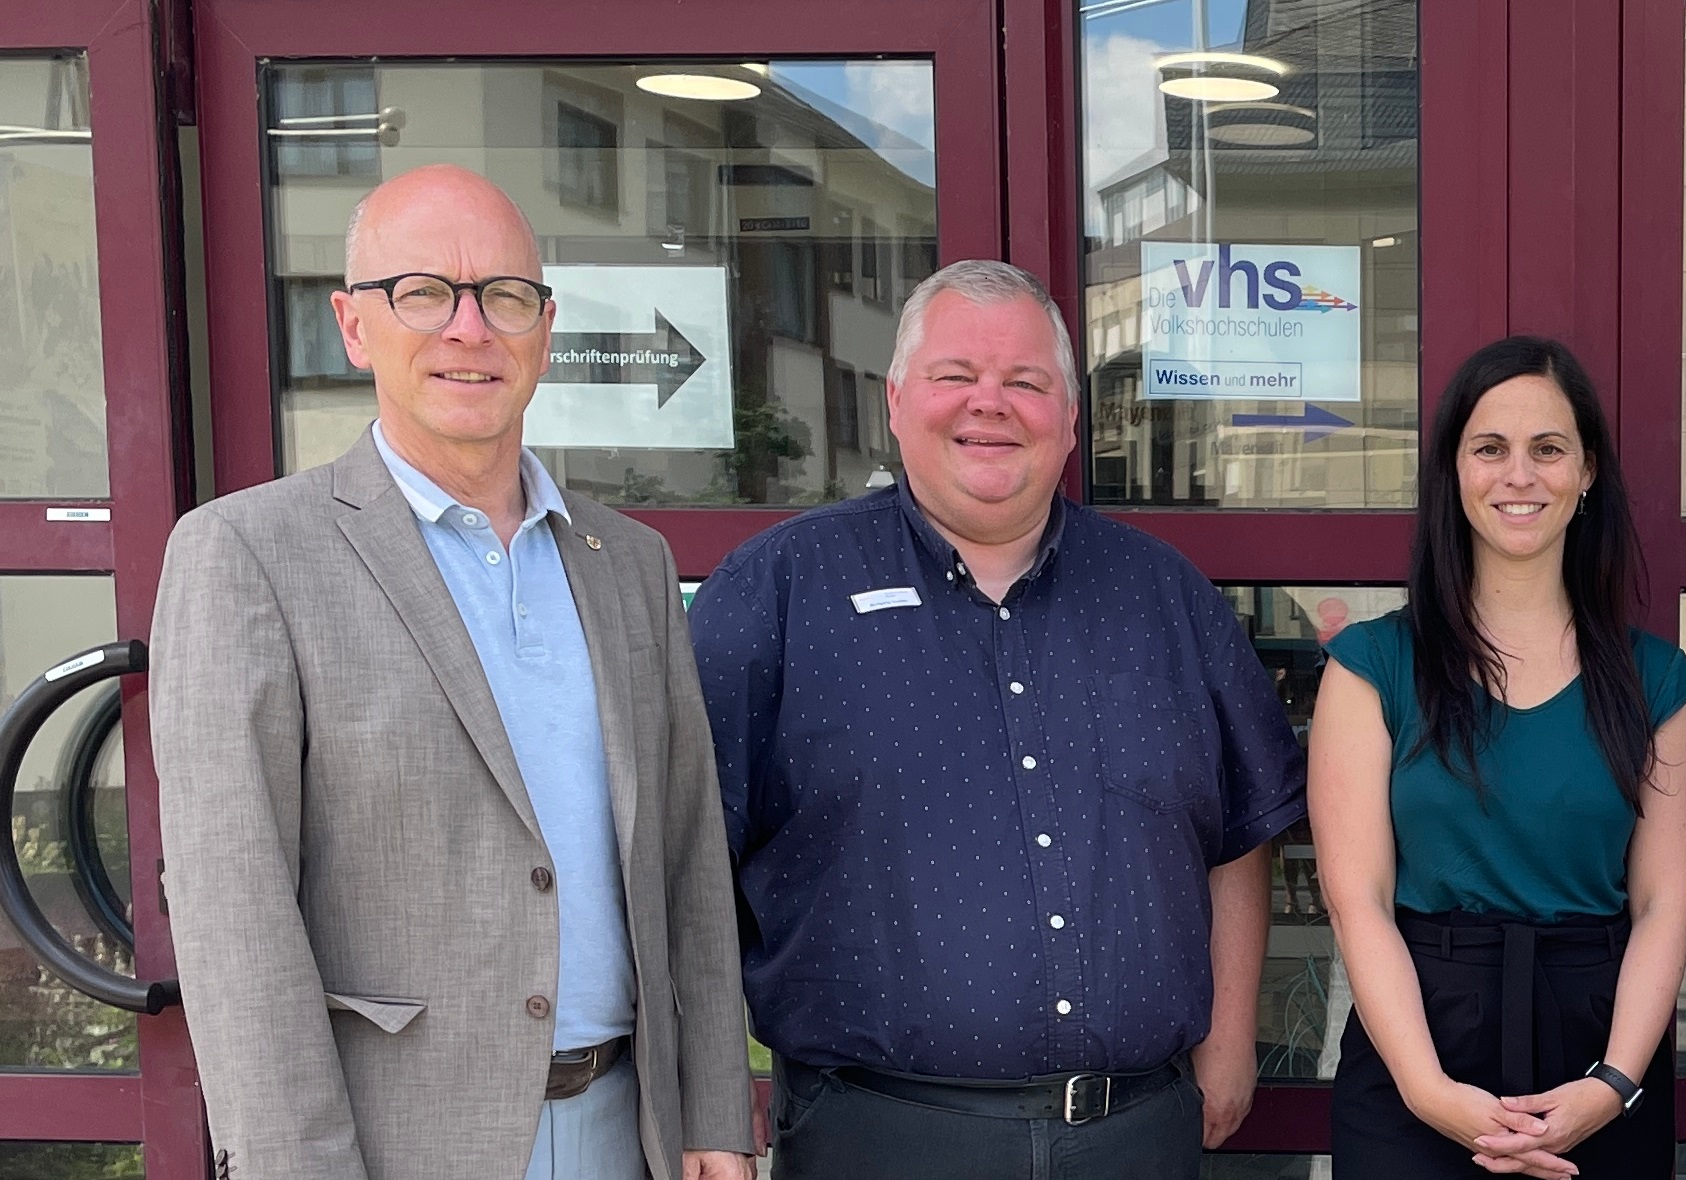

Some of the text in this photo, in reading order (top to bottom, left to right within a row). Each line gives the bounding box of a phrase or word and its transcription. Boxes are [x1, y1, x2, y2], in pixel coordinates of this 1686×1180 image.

[1149, 243, 1303, 311] Die vhs
[1149, 314, 1304, 338] Volkshochschulen
[1155, 369, 1297, 388] Wissen und mehr
